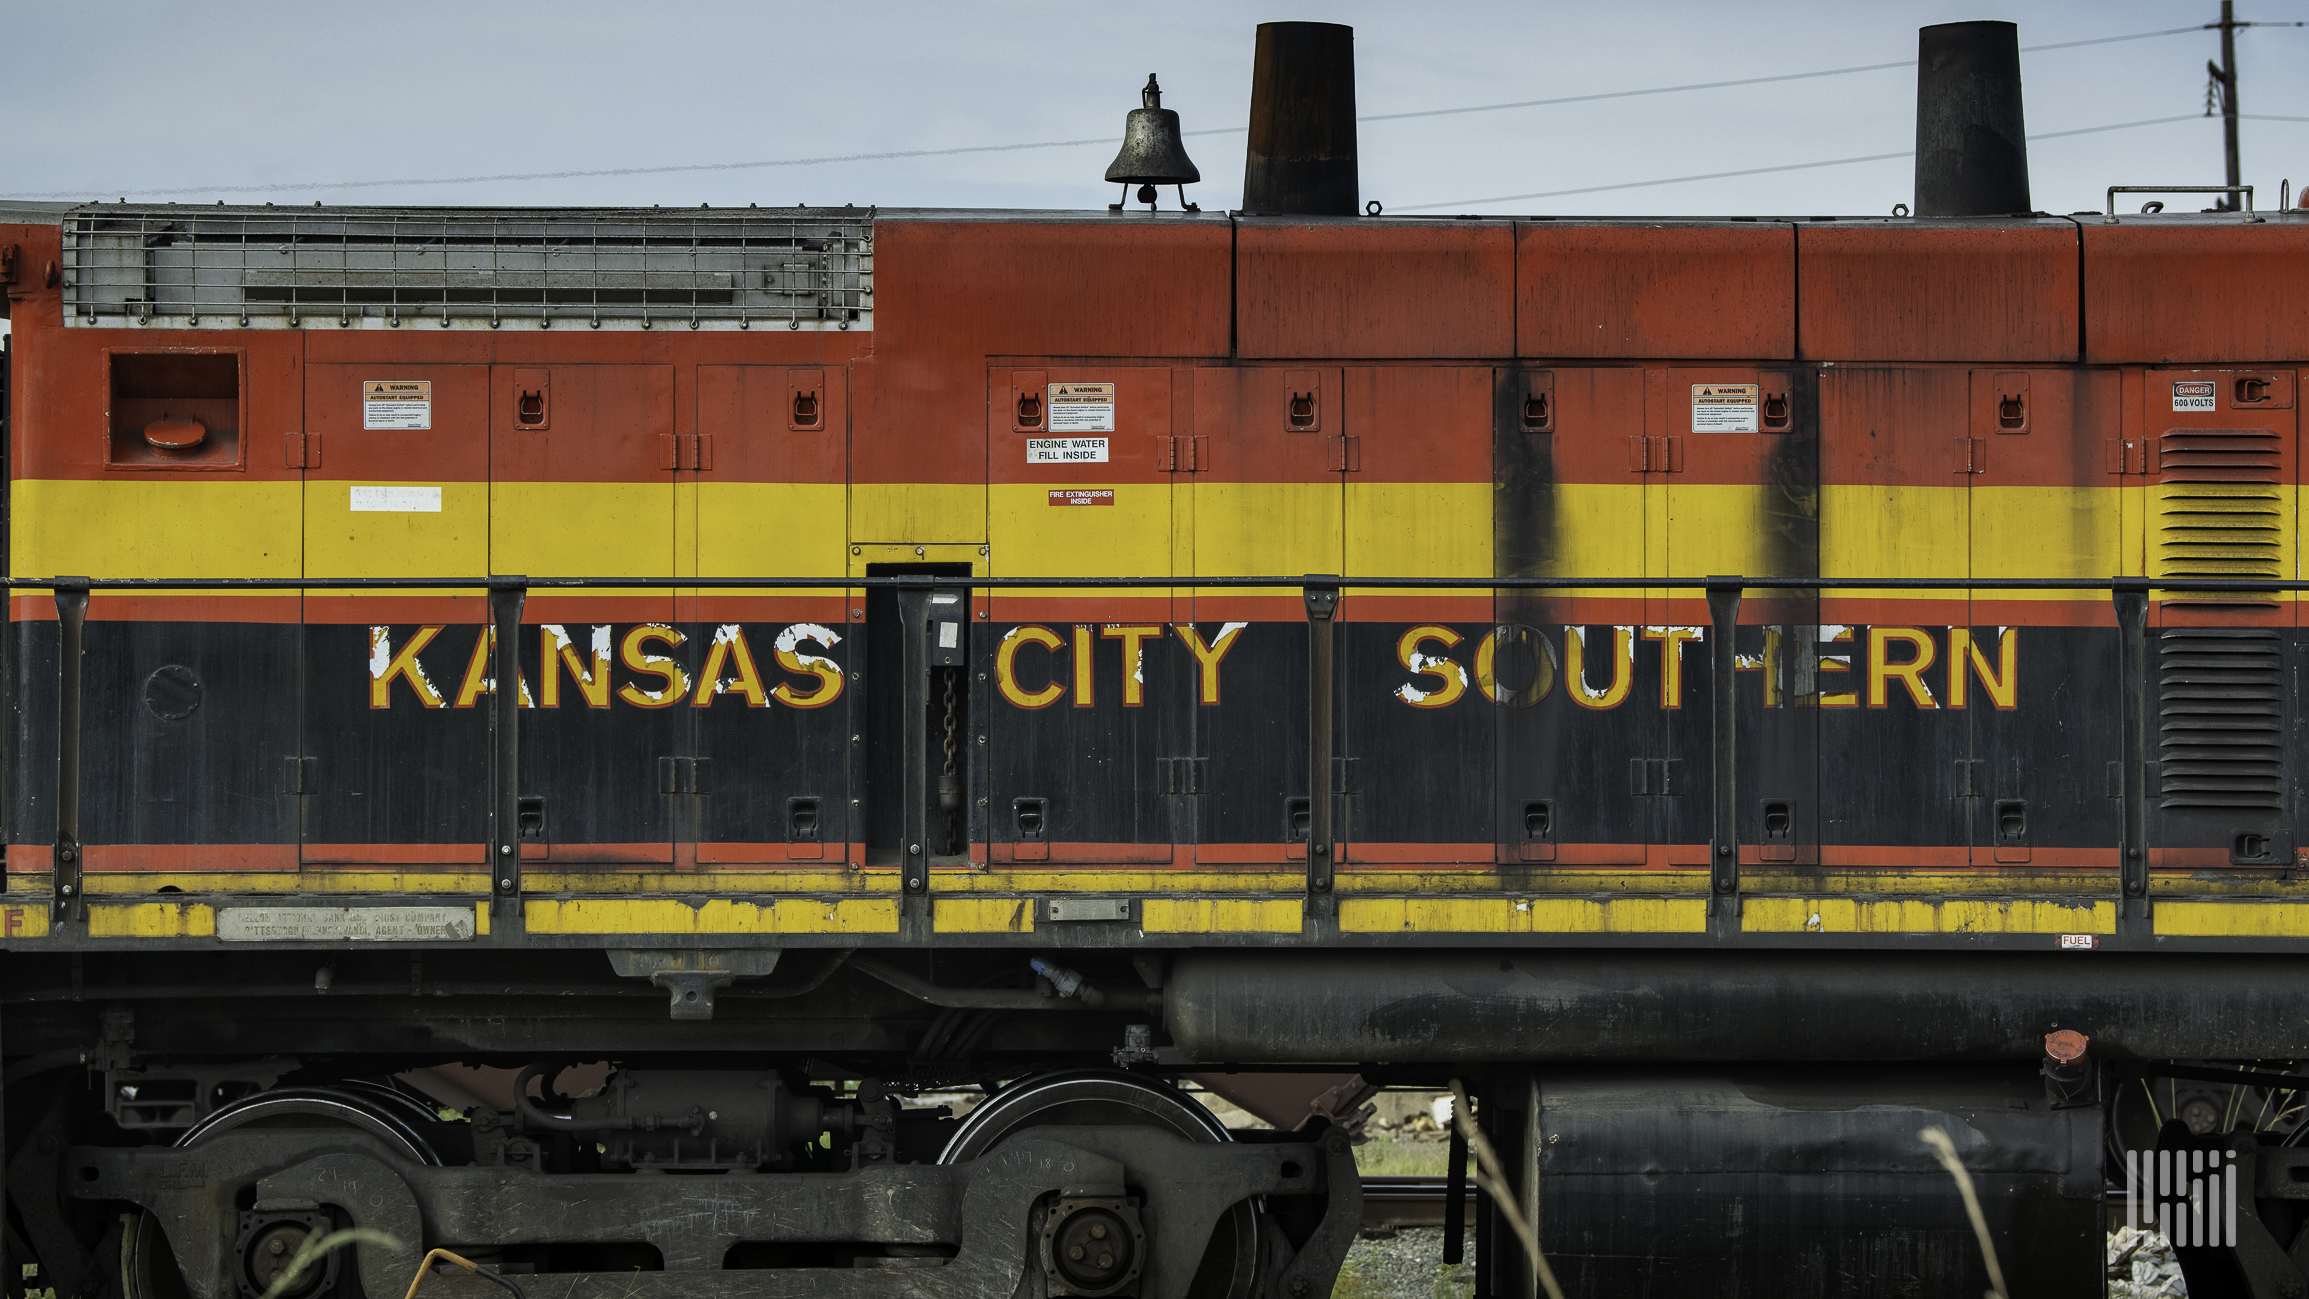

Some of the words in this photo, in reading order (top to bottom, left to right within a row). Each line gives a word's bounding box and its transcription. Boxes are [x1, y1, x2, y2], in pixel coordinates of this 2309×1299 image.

[2174, 399, 2188, 407] 600
[2189, 399, 2214, 407] VOLTS
[1029, 440, 1067, 448] ENGINE
[1072, 440, 1105, 448] WATER
[1038, 451, 1059, 460] FILL
[1063, 451, 1097, 460] INSIDE
[369, 623, 845, 709] KANSAS
[994, 622, 1249, 710] CITY
[1394, 624, 2018, 710] SOUTHERN
[5, 909, 24, 937] F
[376, 925, 404, 935] AGENT
[2063, 936, 2090, 945] FUEL
